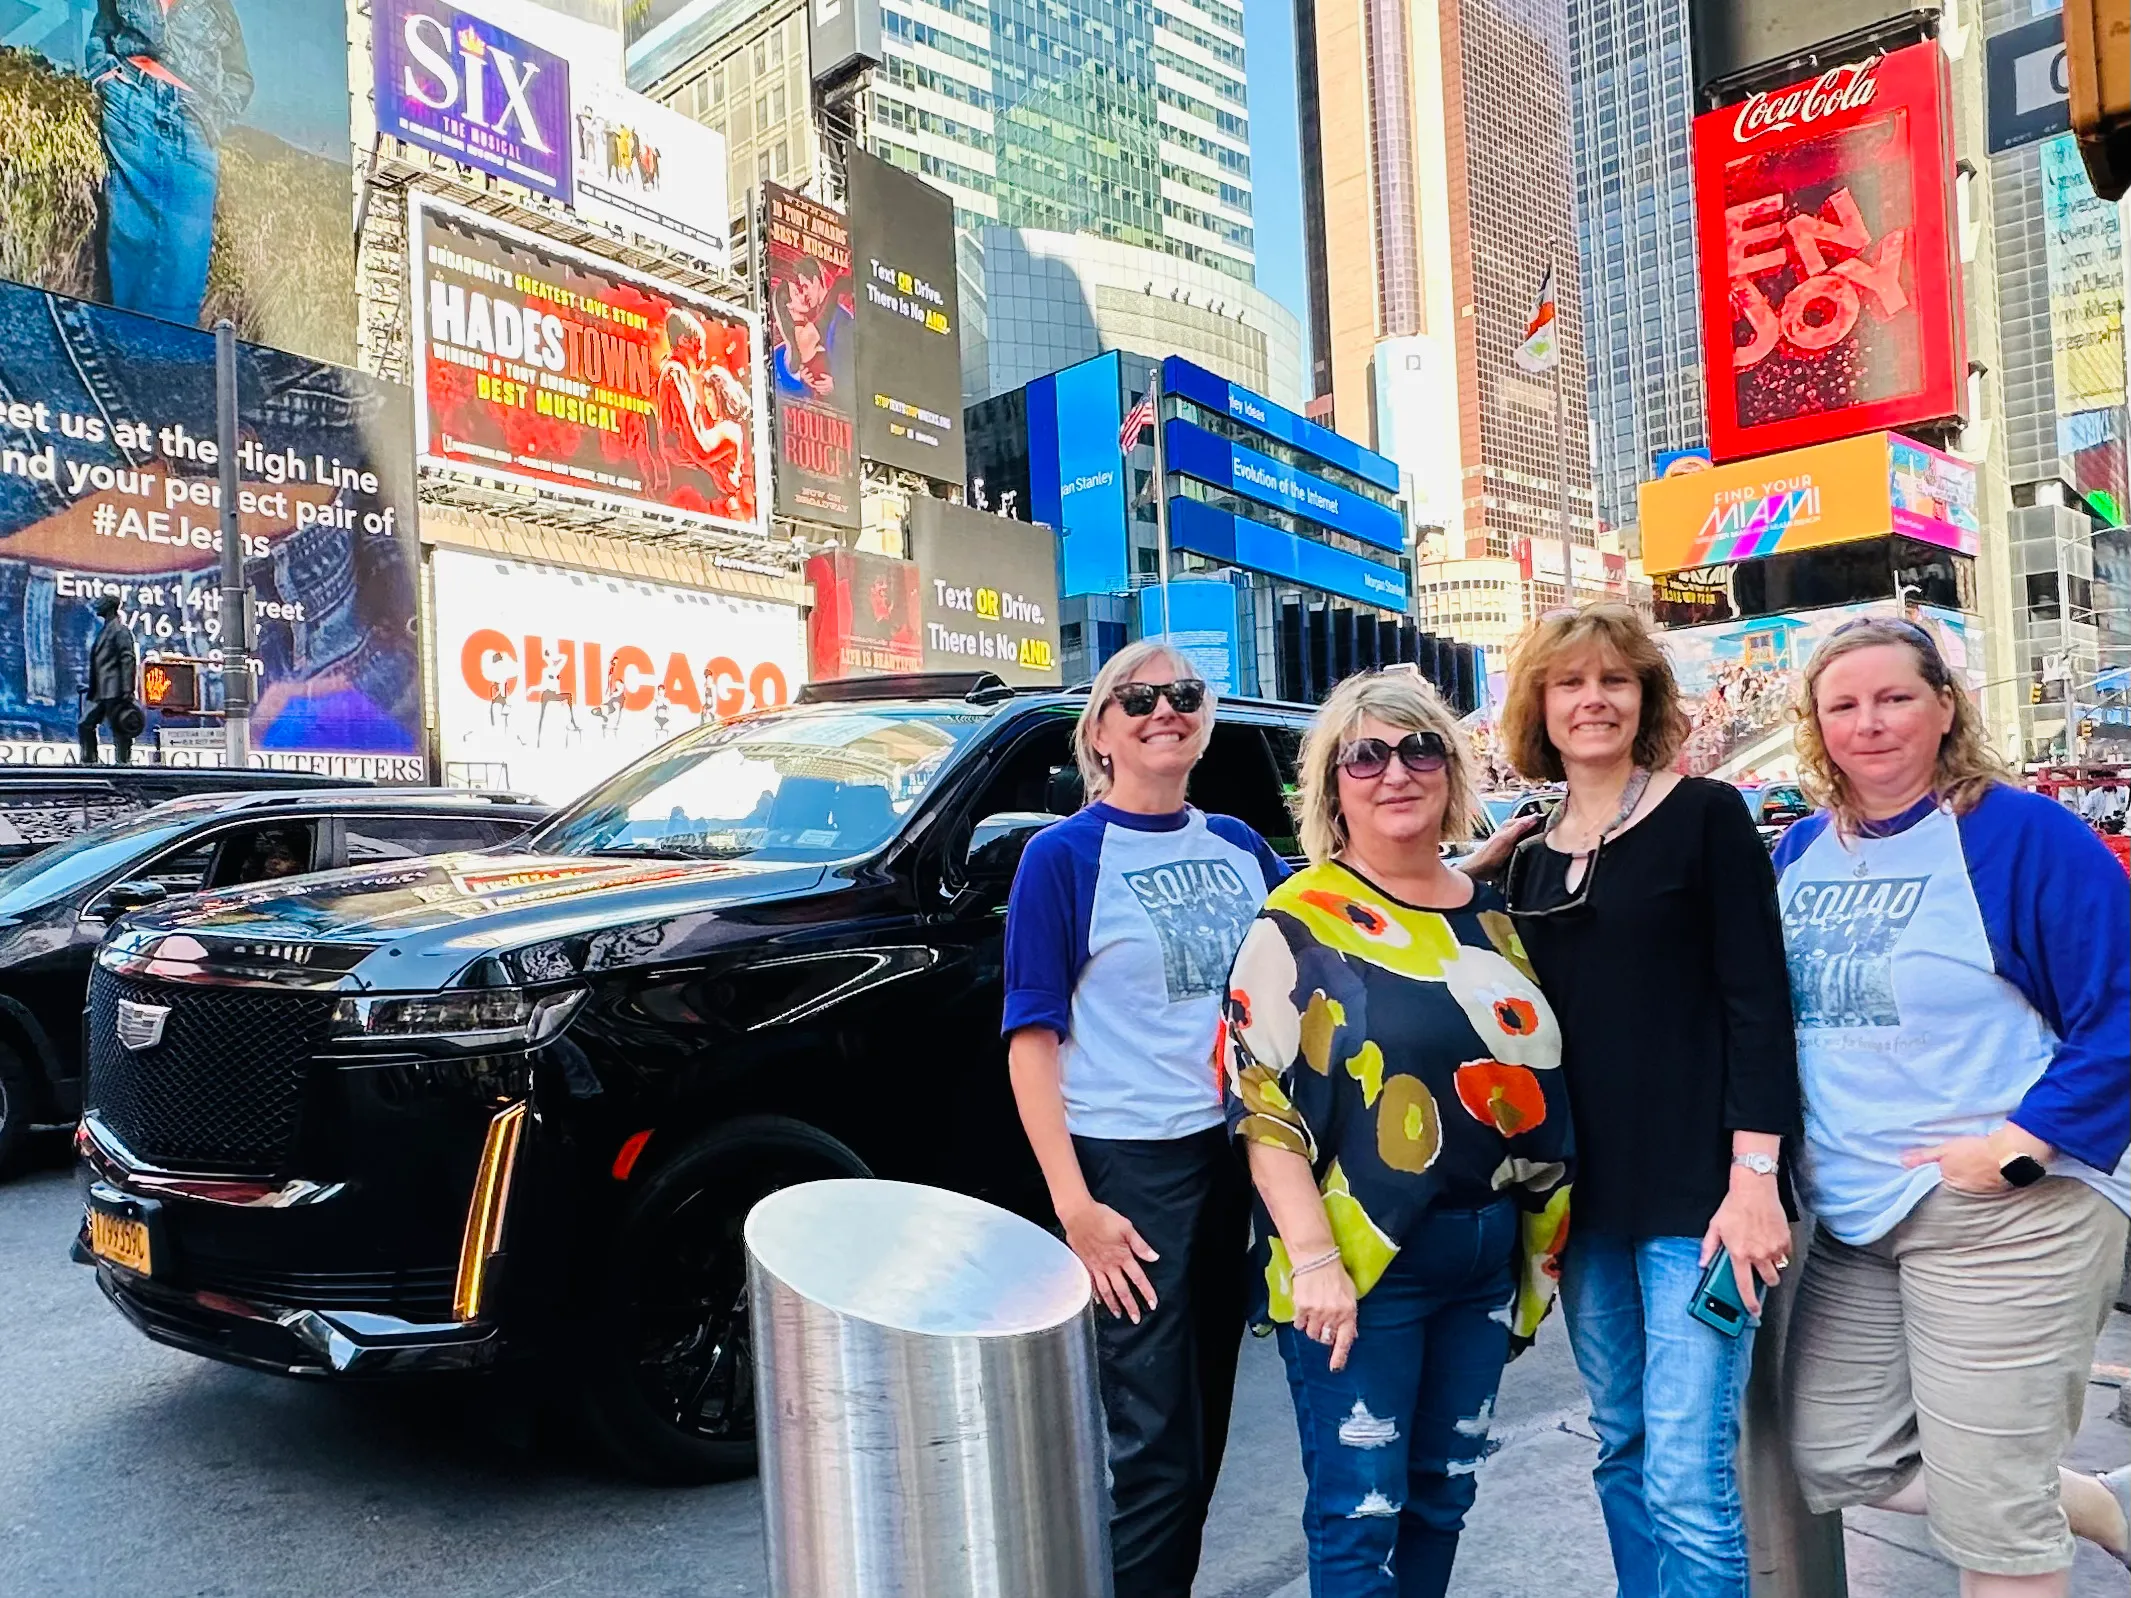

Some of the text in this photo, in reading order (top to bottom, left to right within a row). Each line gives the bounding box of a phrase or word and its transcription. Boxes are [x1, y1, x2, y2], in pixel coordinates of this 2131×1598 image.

[404, 14, 555, 154] SIX
[443, 116, 521, 160] THE MUSICAL
[773, 221, 800, 249] BEST
[783, 205, 810, 230] TONY
[514, 272, 576, 309] GREATEST
[579, 295, 609, 320] LOVE
[612, 306, 648, 331] STORY
[870, 258, 944, 306] Text OR Drive.
[866, 282, 951, 335] There Is No AND.
[429, 279, 652, 398] HADESTOWN
[504, 361, 537, 385] TONY
[476, 373, 621, 434] BEST MUSICAL
[784, 406, 847, 450] MOULIN
[61, 412, 105, 443] us
[114, 421, 152, 453] at
[159, 424, 219, 465] the
[315, 453, 379, 495] Line
[66, 459, 155, 496] your
[164, 476, 288, 521] perect
[296, 499, 357, 532] pair
[363, 506, 395, 537] of
[1075, 470, 1114, 492] Stanley
[1232, 456, 1340, 515] Evolution of the Internet
[1713, 474, 1812, 505] FIND YOUR
[1697, 485, 1821, 537] MIAMI
[138, 587, 165, 607] at
[932, 578, 1046, 625] Text OR Drive.
[927, 621, 976, 656] There
[979, 630, 995, 658] Is
[996, 632, 1018, 662] No
[1019, 637, 1056, 671] AND.
[461, 628, 788, 717] CHICAGO
[247, 754, 422, 781] OUTFITTERS
[1128, 863, 1243, 909] SQUAD
[1784, 881, 1922, 927] SQUAD
